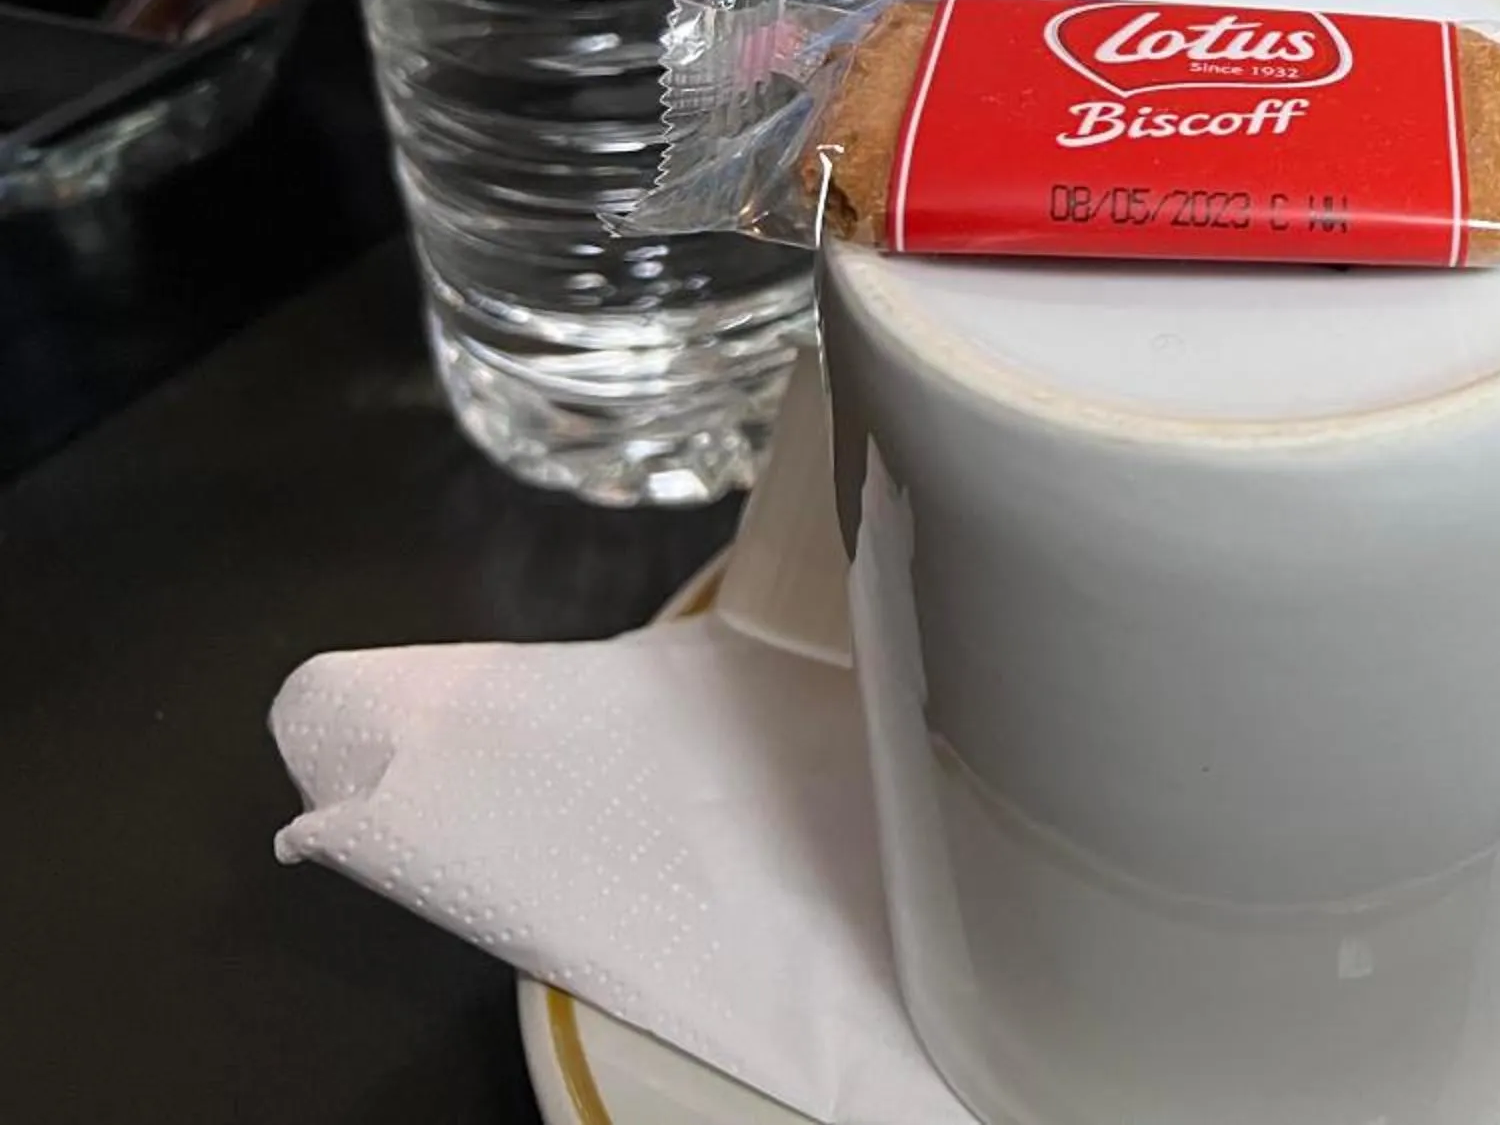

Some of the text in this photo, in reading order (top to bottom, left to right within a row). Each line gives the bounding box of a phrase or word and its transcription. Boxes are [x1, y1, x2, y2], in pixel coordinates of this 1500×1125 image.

[1094, 11, 1316, 64] Lotus
[1189, 61, 1300, 78] Since 1932
[1055, 98, 1310, 148] Biscoff
[1050, 184, 1250, 229] 08/05/2023
